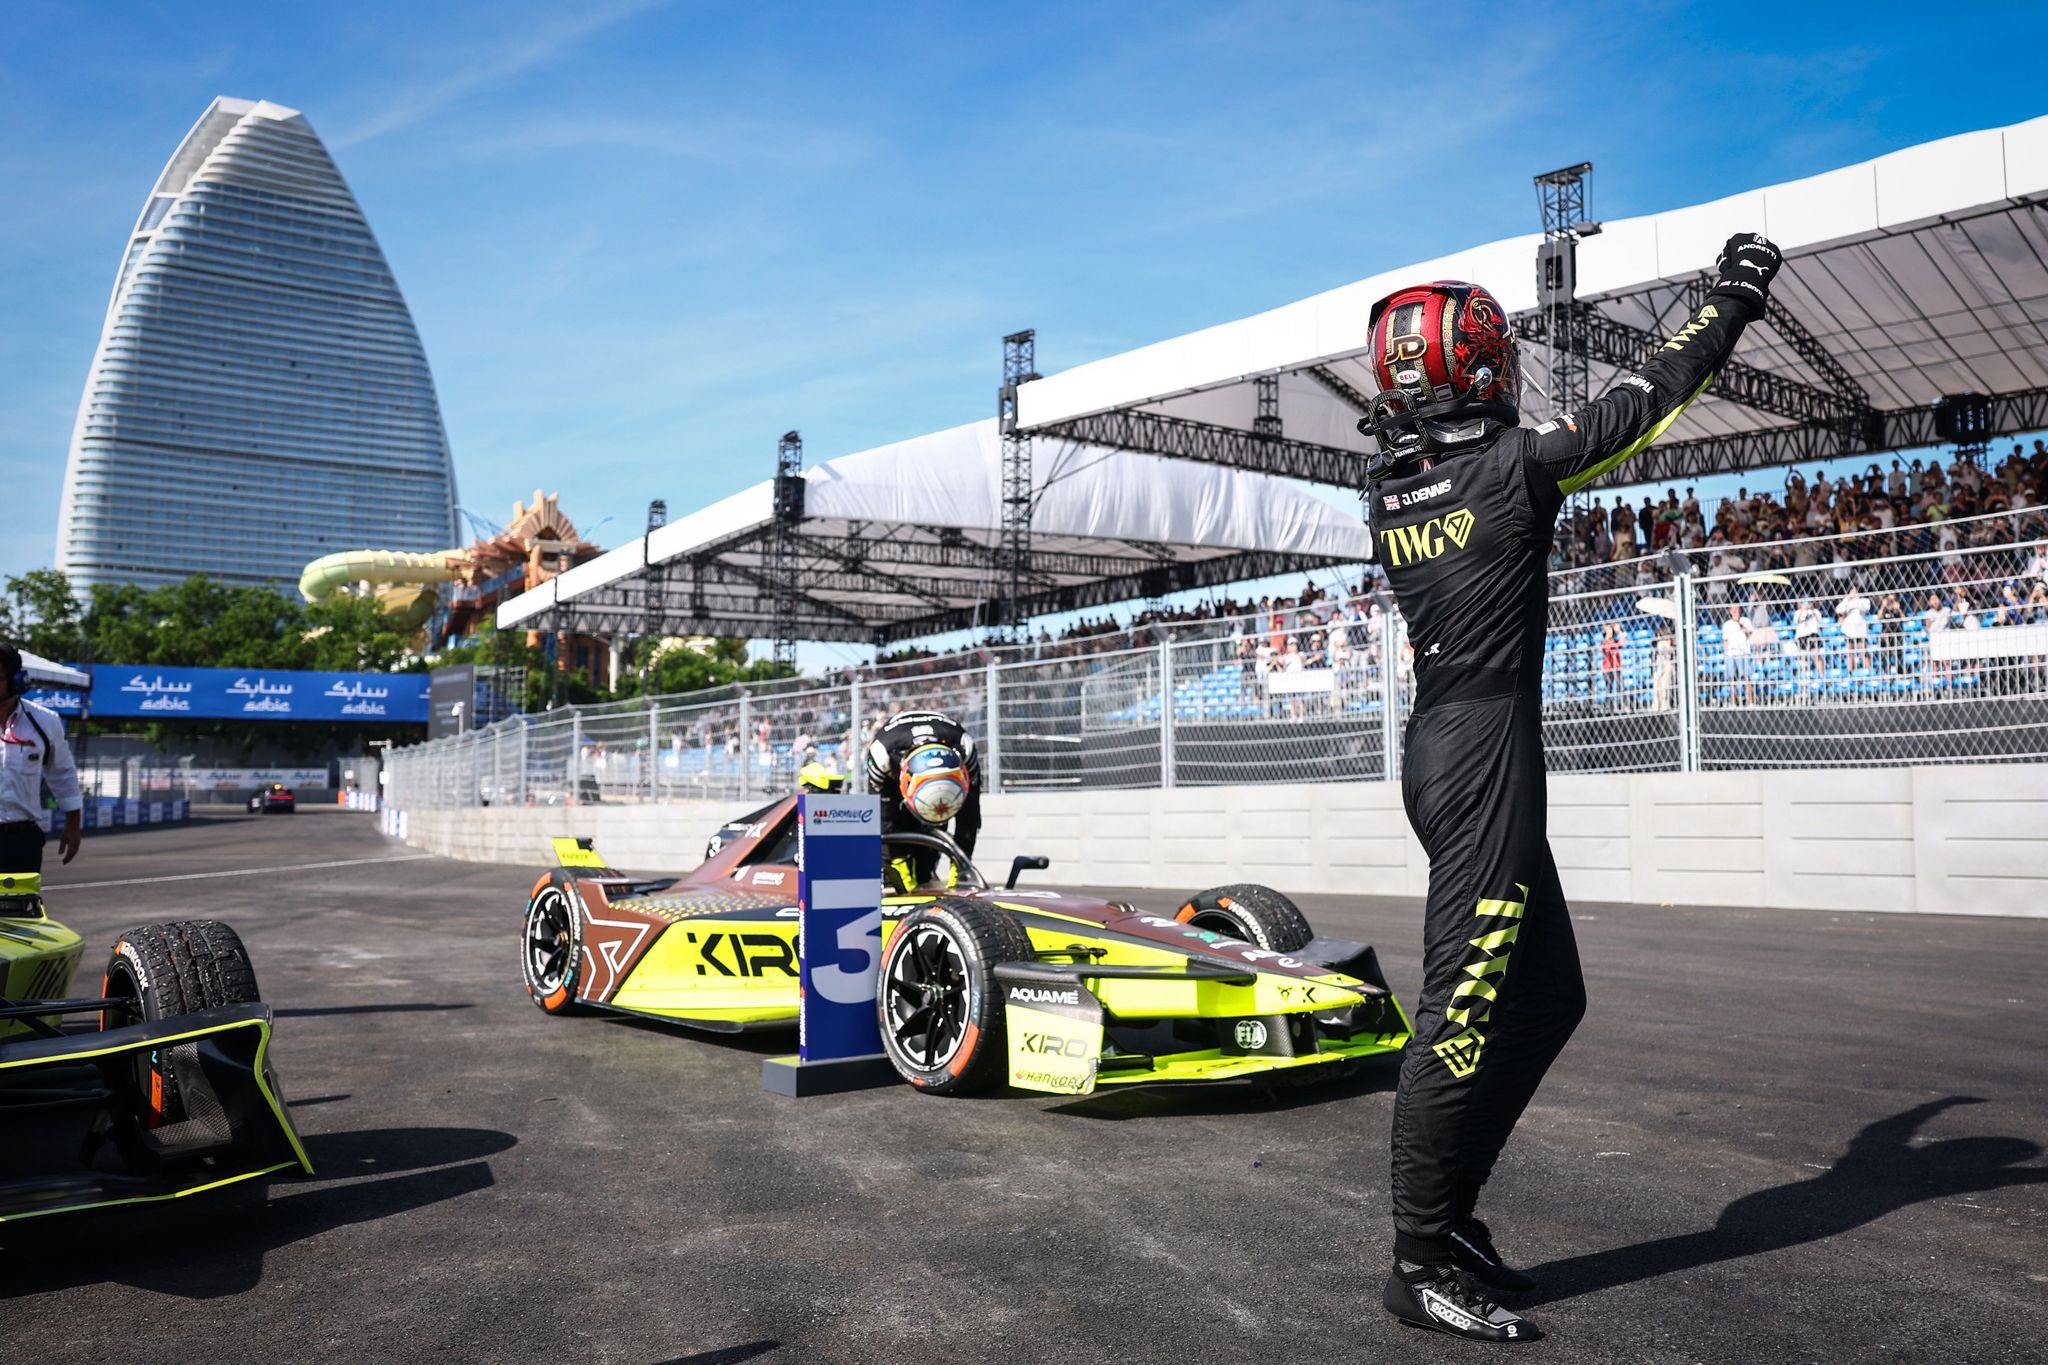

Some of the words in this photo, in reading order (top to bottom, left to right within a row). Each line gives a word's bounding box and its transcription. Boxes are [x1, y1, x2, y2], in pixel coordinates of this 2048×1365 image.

[1737, 243, 1777, 260] ANDRETTI
[1659, 316, 1710, 352] TWG
[1399, 373, 1417, 381] BELL
[1380, 517, 1445, 566] TWG
[139, 695, 191, 710] sabic
[242, 696, 292, 712] sabic
[341, 700, 387, 715] sabic
[687, 932, 800, 978] KIR
[811, 879, 881, 1004] 3
[1447, 882, 1529, 1028] TWG
[1021, 1032, 1087, 1058] KIRO
[1430, 1301, 1471, 1330] sparco
